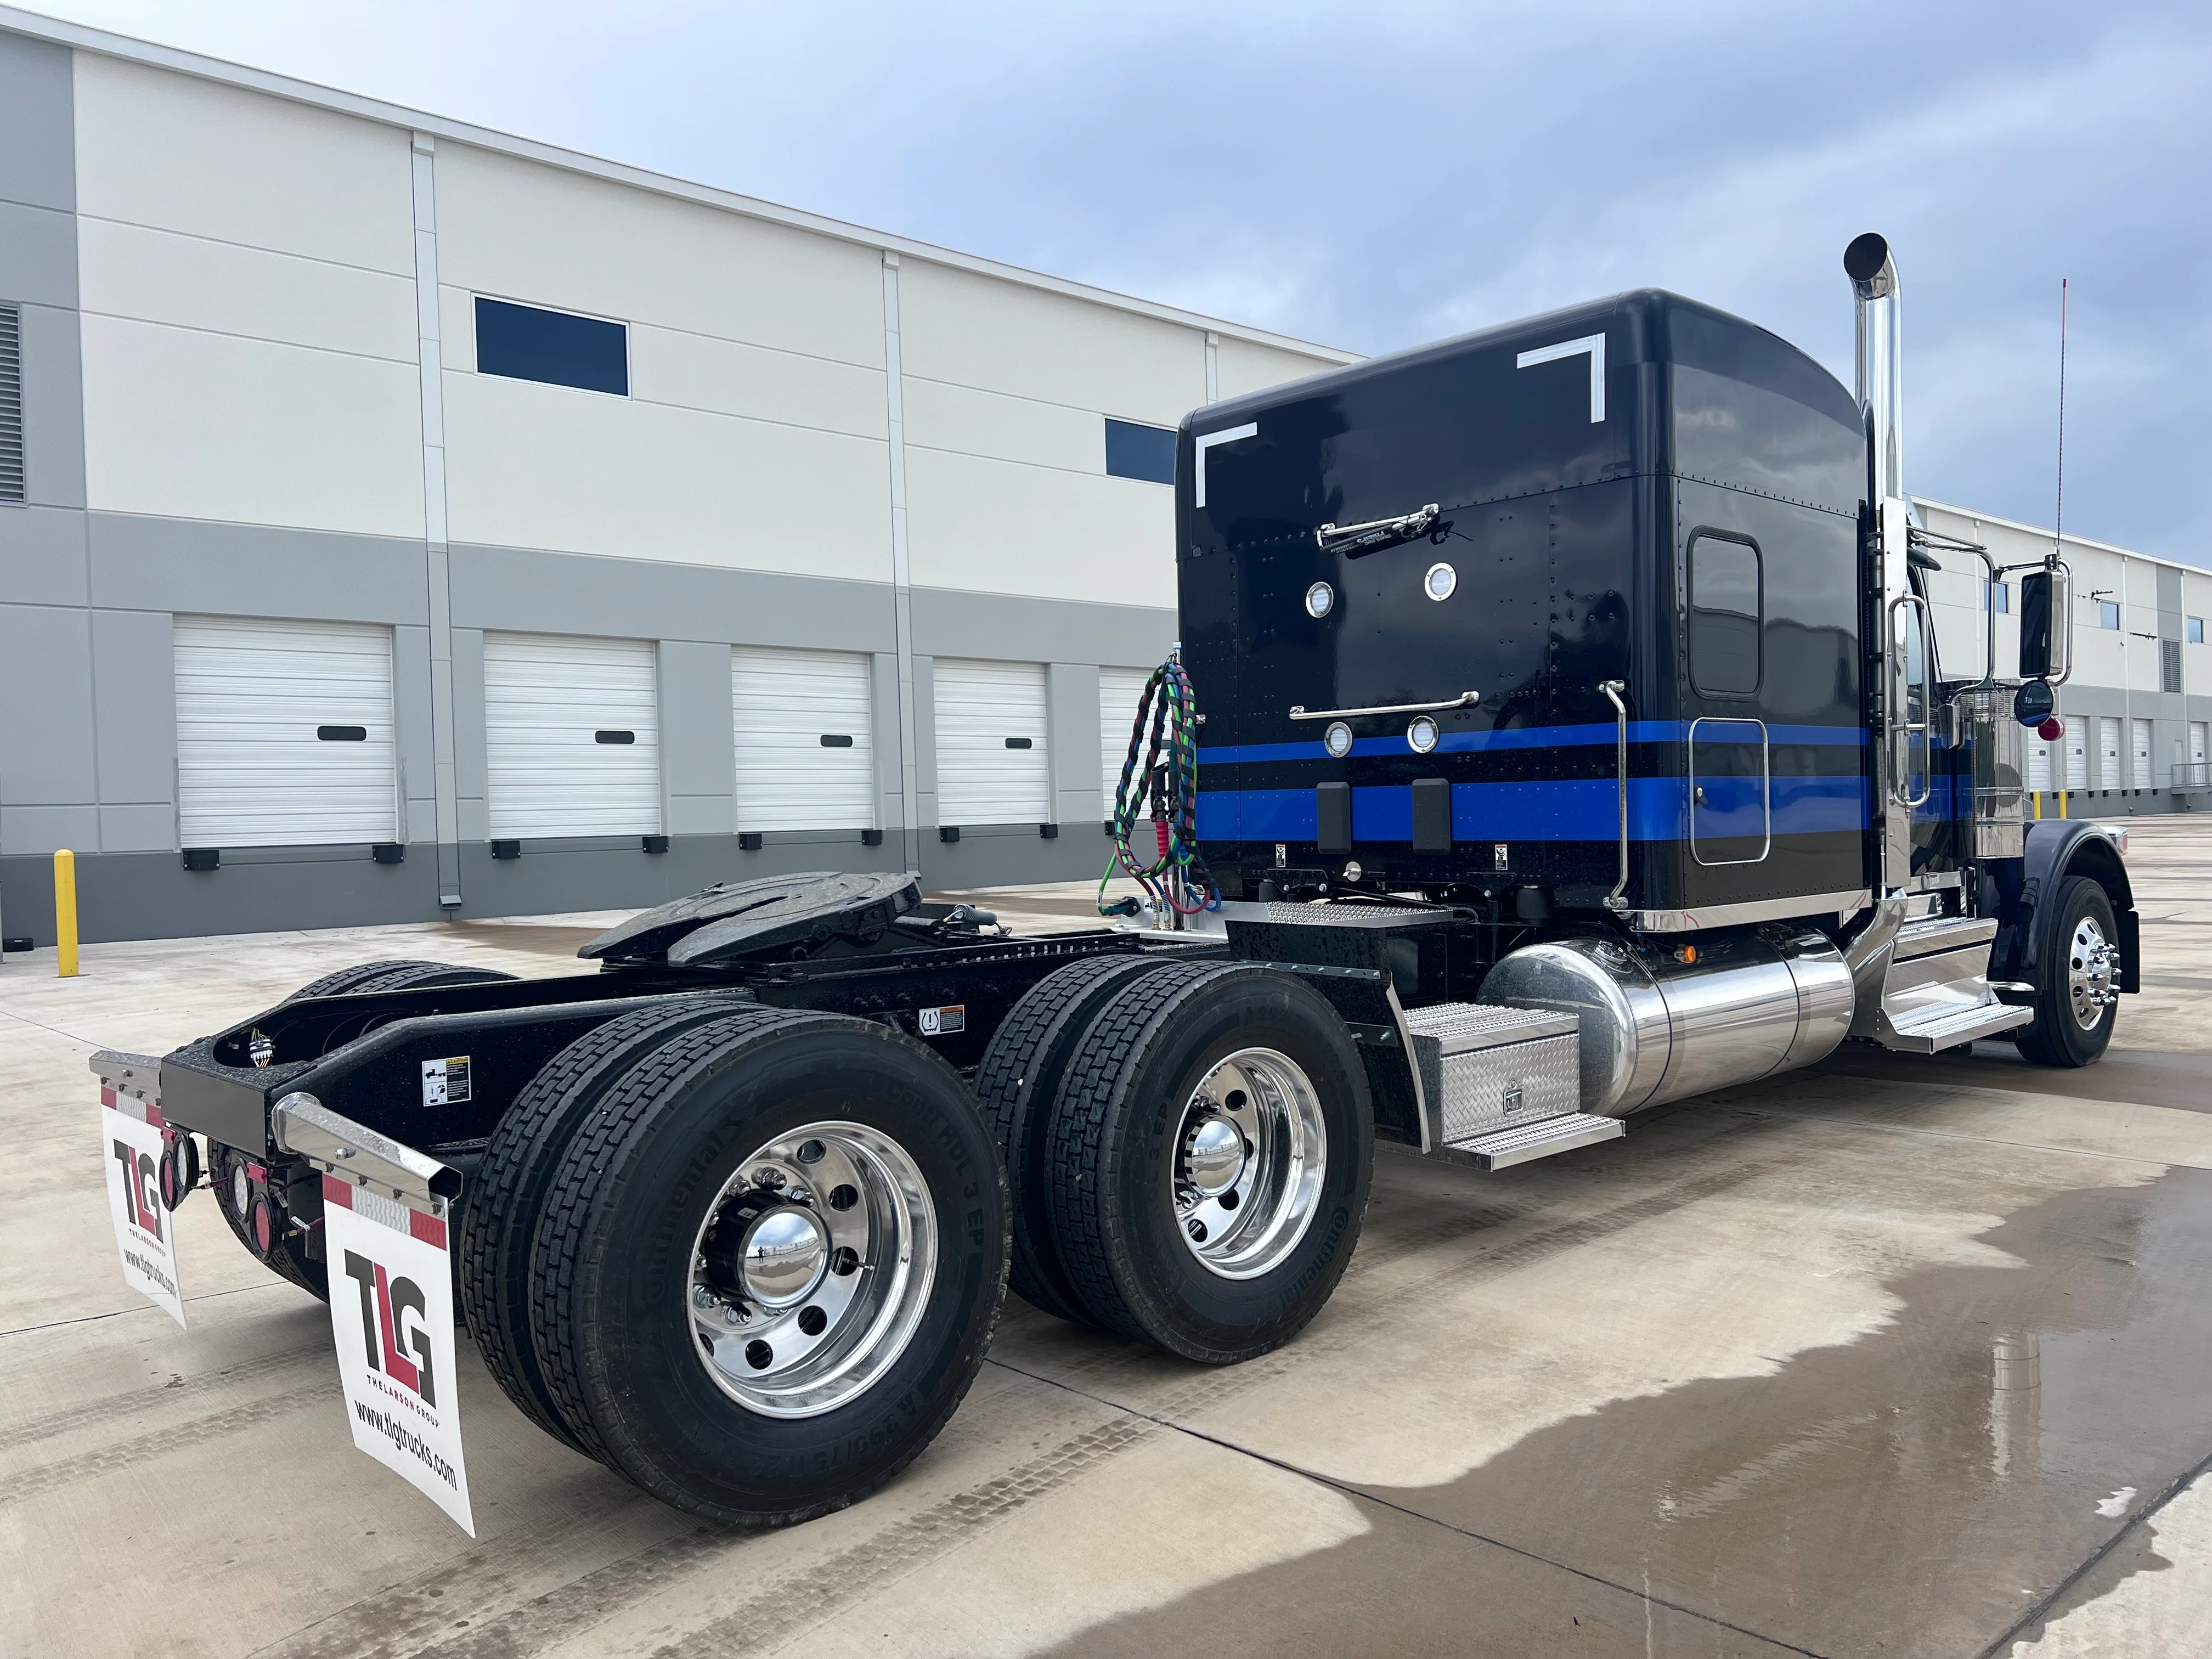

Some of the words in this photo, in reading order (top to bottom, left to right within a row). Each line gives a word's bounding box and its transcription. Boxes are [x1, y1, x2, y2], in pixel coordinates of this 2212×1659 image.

[938, 1126, 972, 1178] HDL
[1153, 1102, 1169, 1136] EP
[114, 1139, 163, 1244] TLG
[645, 1129, 727, 1310] Continental
[963, 1181, 979, 1200] 3
[967, 1207, 985, 1246] EP
[1279, 1205, 1350, 1311] Continental
[344, 1249, 437, 1409] TLG
[354, 1400, 458, 1491] www.tlgtrucks.com
[416, 1405, 438, 1429] GROUP
